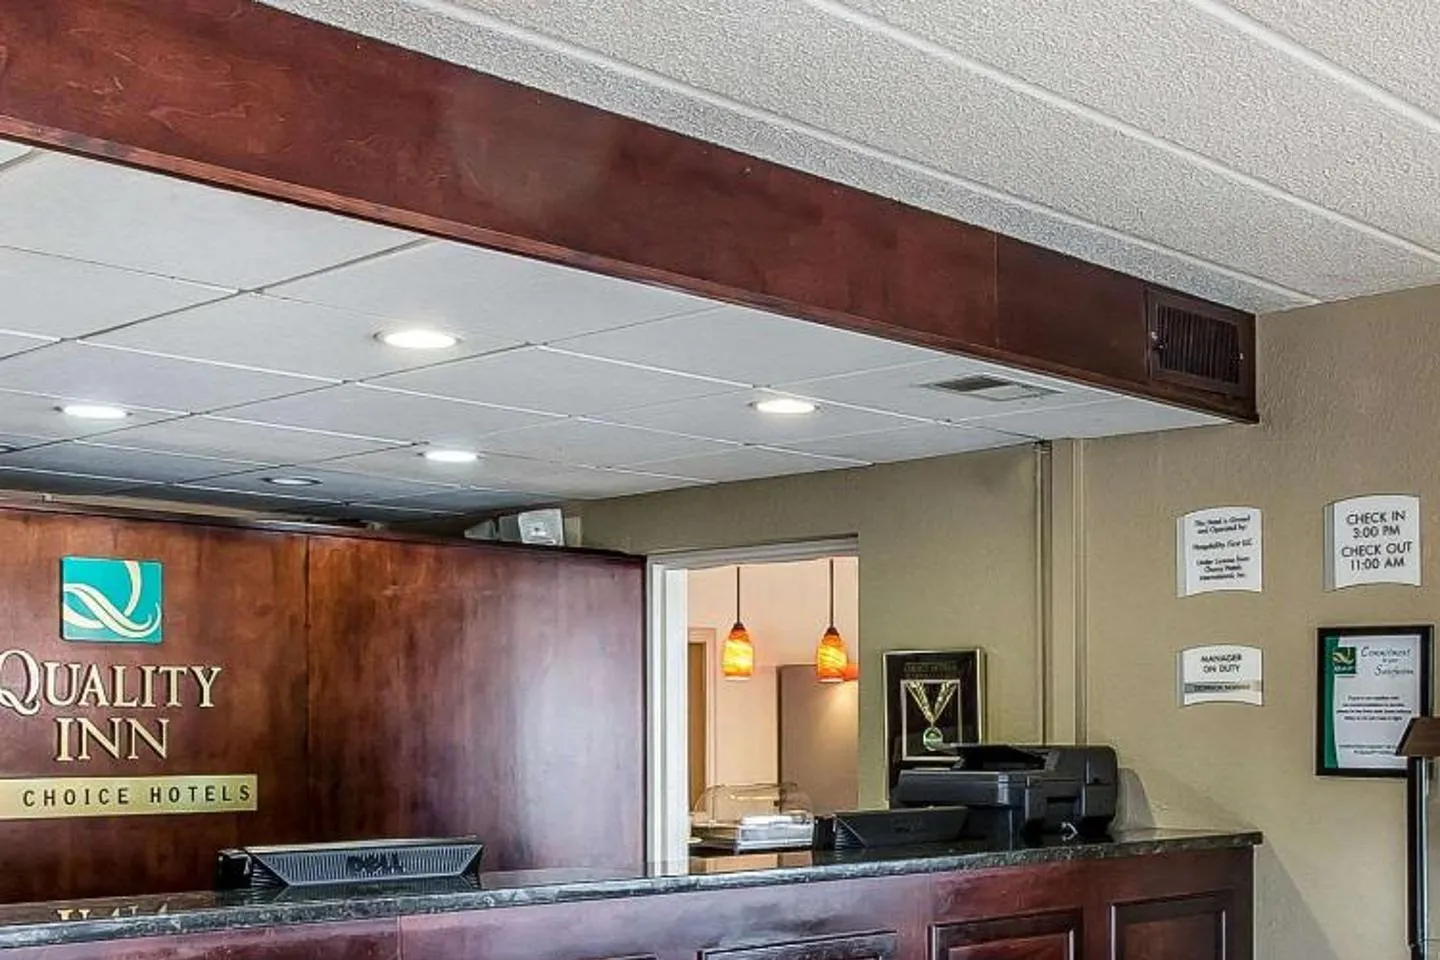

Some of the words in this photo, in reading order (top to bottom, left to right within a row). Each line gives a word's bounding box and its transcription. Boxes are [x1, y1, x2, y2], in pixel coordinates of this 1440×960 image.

[1346, 512, 1387, 524] CHECK
[1391, 510, 1406, 521] IN
[1353, 526, 1379, 538] 3:00
[1382, 525, 1400, 536] PM
[1341, 545, 1381, 557] CHECK
[1386, 541, 1412, 554] OUT
[1351, 558, 1380, 571] 11:00
[1384, 557, 1404, 568] AM
[1201, 653, 1242, 662] MANAGER
[1203, 665, 1216, 673] ON
[1219, 664, 1240, 672] DUTY
[54, 716, 170, 762] INN
[22, 787, 130, 808] CHOICE
[150, 784, 250, 804] HOTELS
